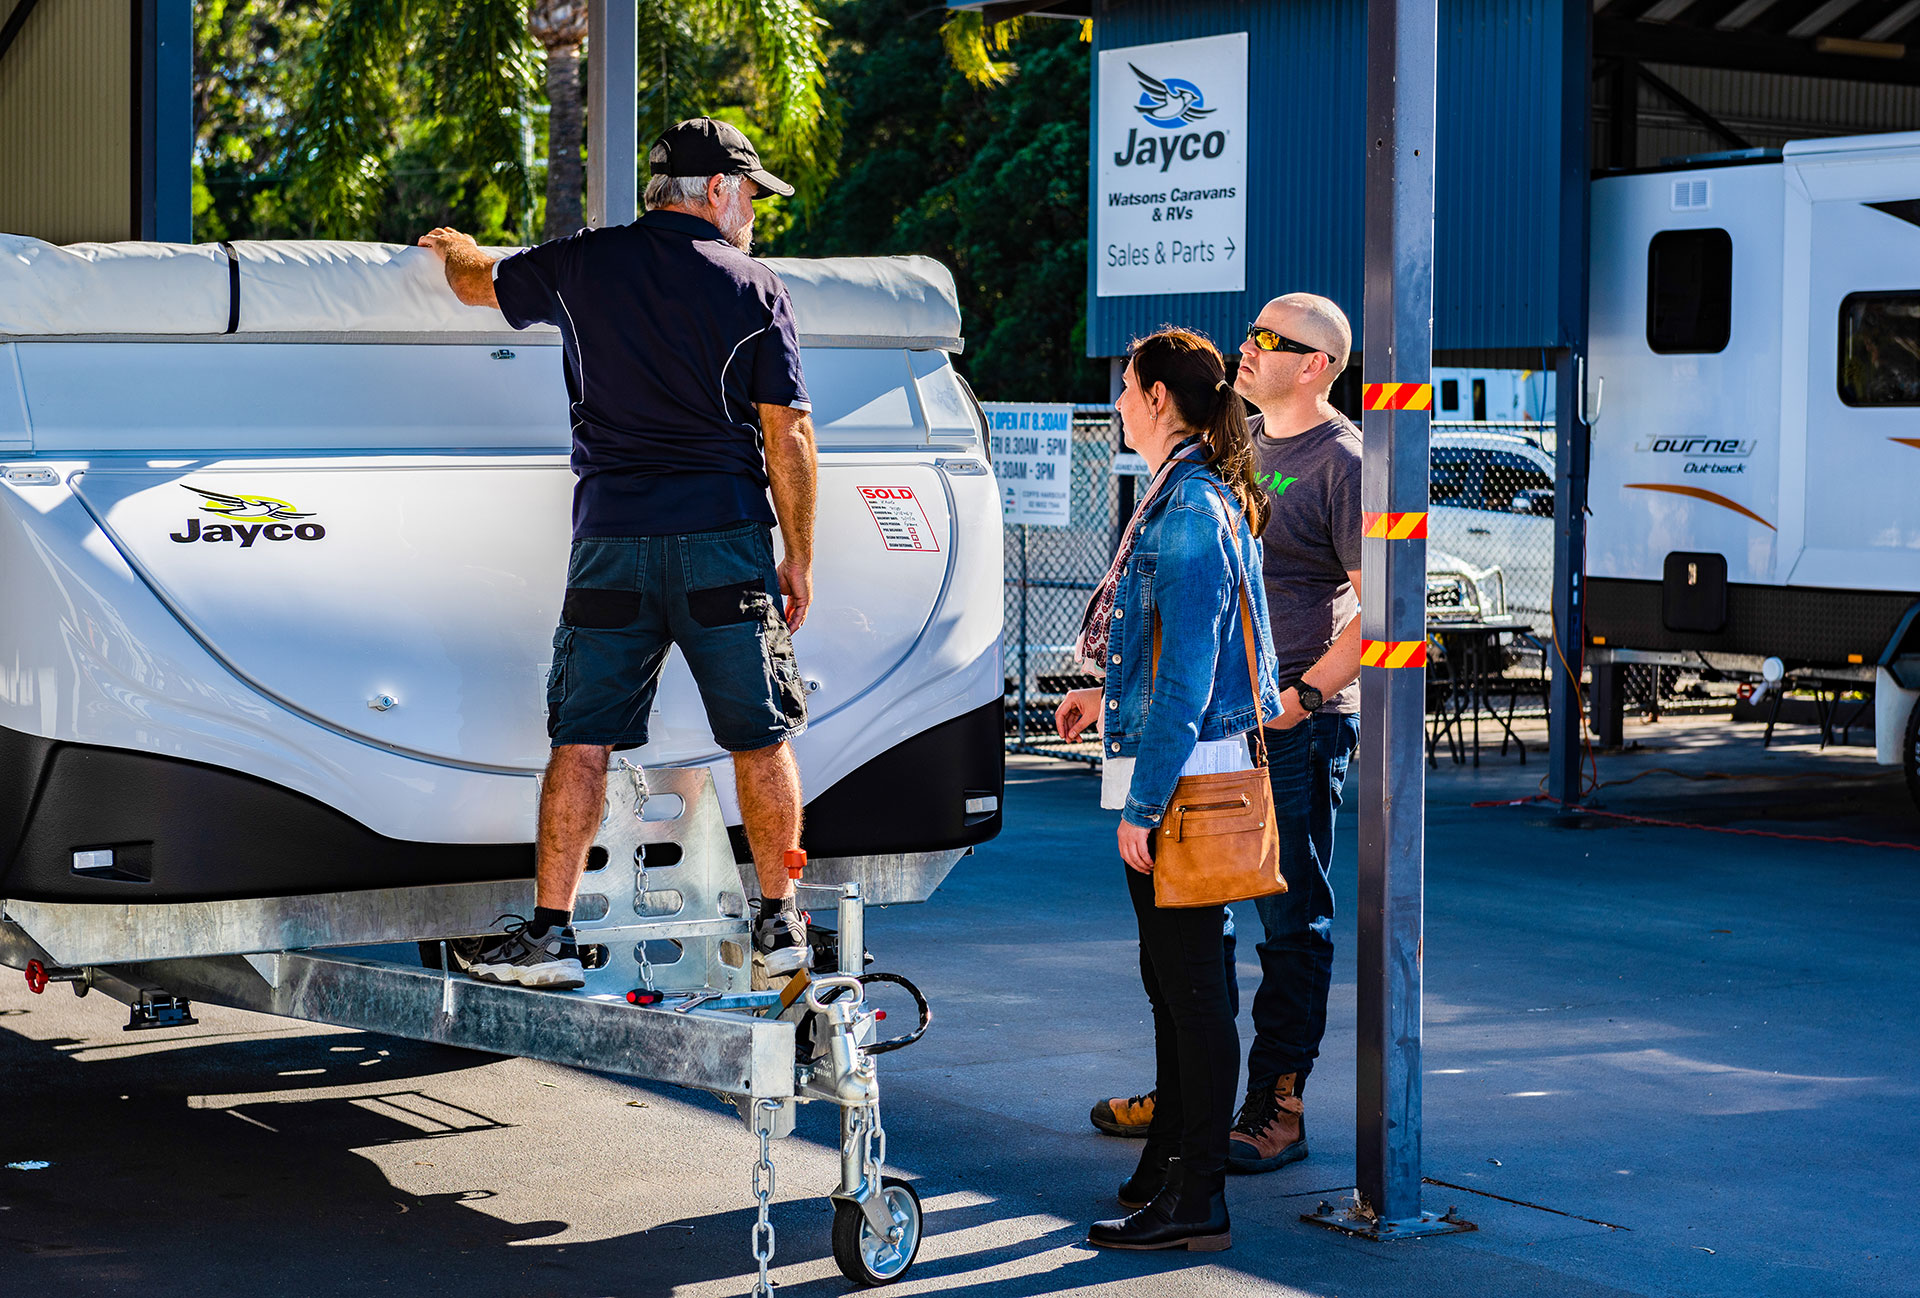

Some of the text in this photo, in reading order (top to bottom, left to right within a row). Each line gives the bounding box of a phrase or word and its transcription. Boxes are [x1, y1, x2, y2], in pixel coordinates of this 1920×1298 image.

[1114, 128, 1225, 173] Jayco
[1108, 187, 1236, 207] Watsons Caravans
[1152, 206, 1193, 221] & RVs
[1107, 240, 1215, 267] Sales & Parts
[995, 412, 1018, 430] OPEN
[1019, 412, 1031, 430] AT
[1032, 412, 1068, 431] 8.30AM
[1004, 437, 1039, 455] 8.30AM
[1046, 438, 1067, 455] 5PM
[1634, 434, 1757, 457] Journey
[1035, 462, 1055, 480] 3PM
[1683, 462, 1746, 474] Outback
[862, 488, 913, 500] SOLD
[169, 518, 326, 548] Jayco
